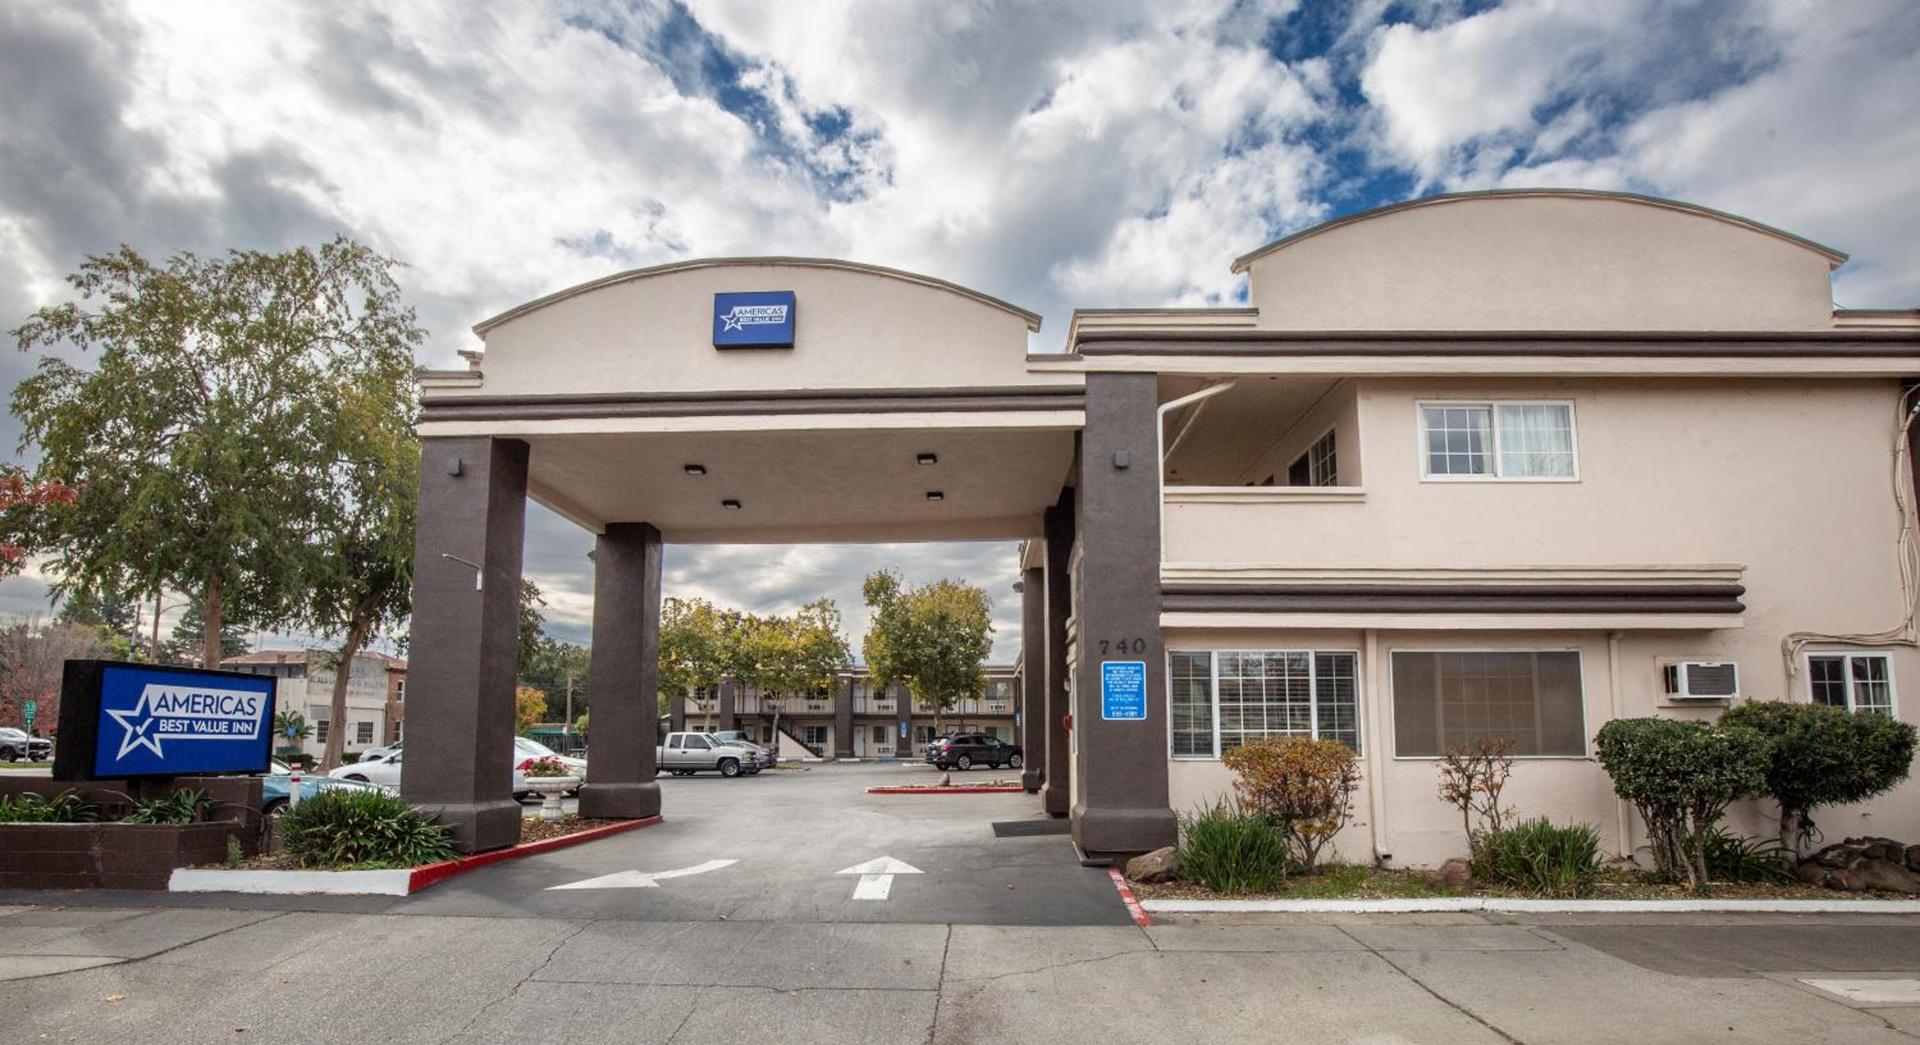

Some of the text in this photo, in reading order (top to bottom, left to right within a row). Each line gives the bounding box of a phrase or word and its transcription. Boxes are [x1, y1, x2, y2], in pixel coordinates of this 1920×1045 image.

[737, 307, 784, 316] AMERICAS
[1099, 638, 1146, 655] 740
[154, 690, 257, 716] AMERICAS
[159, 719, 253, 733] BEST VALUE INN
